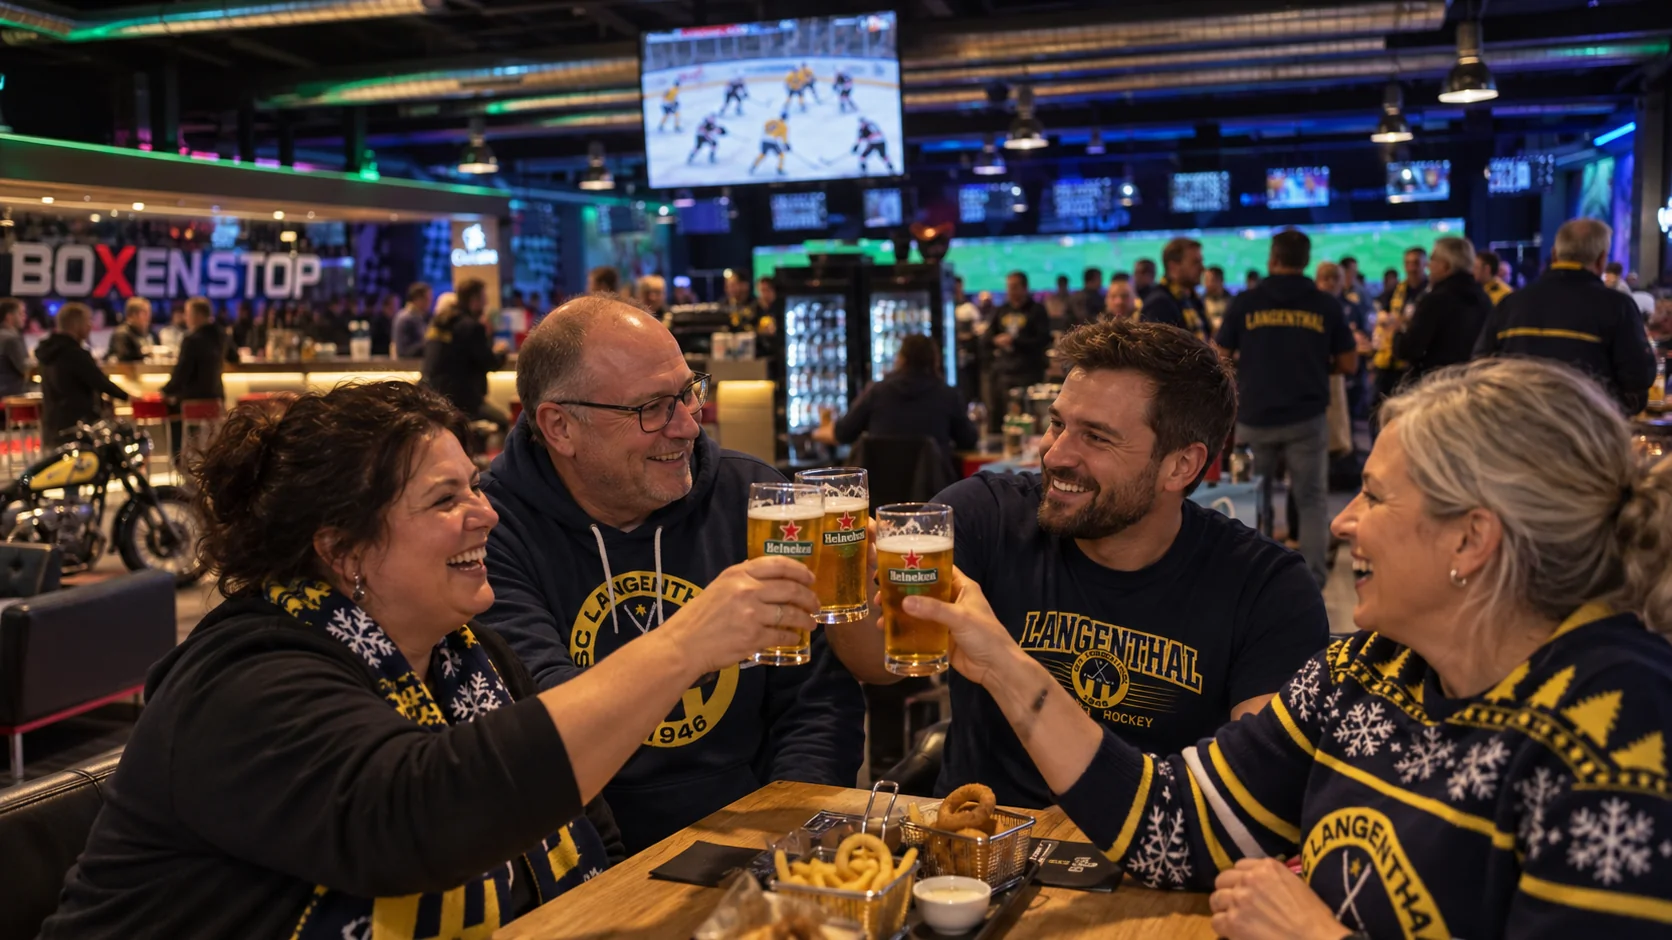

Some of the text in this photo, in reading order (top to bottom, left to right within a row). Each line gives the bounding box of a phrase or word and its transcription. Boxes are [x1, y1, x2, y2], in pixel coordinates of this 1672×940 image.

[11, 243, 321, 298] BOXENSTOP
[889, 569, 937, 583] Heineken
[1018, 610, 1203, 695] LANGENTHAL
[1103, 709, 1154, 728] HOCKEY
[1310, 814, 1440, 940] LANGENTHA
